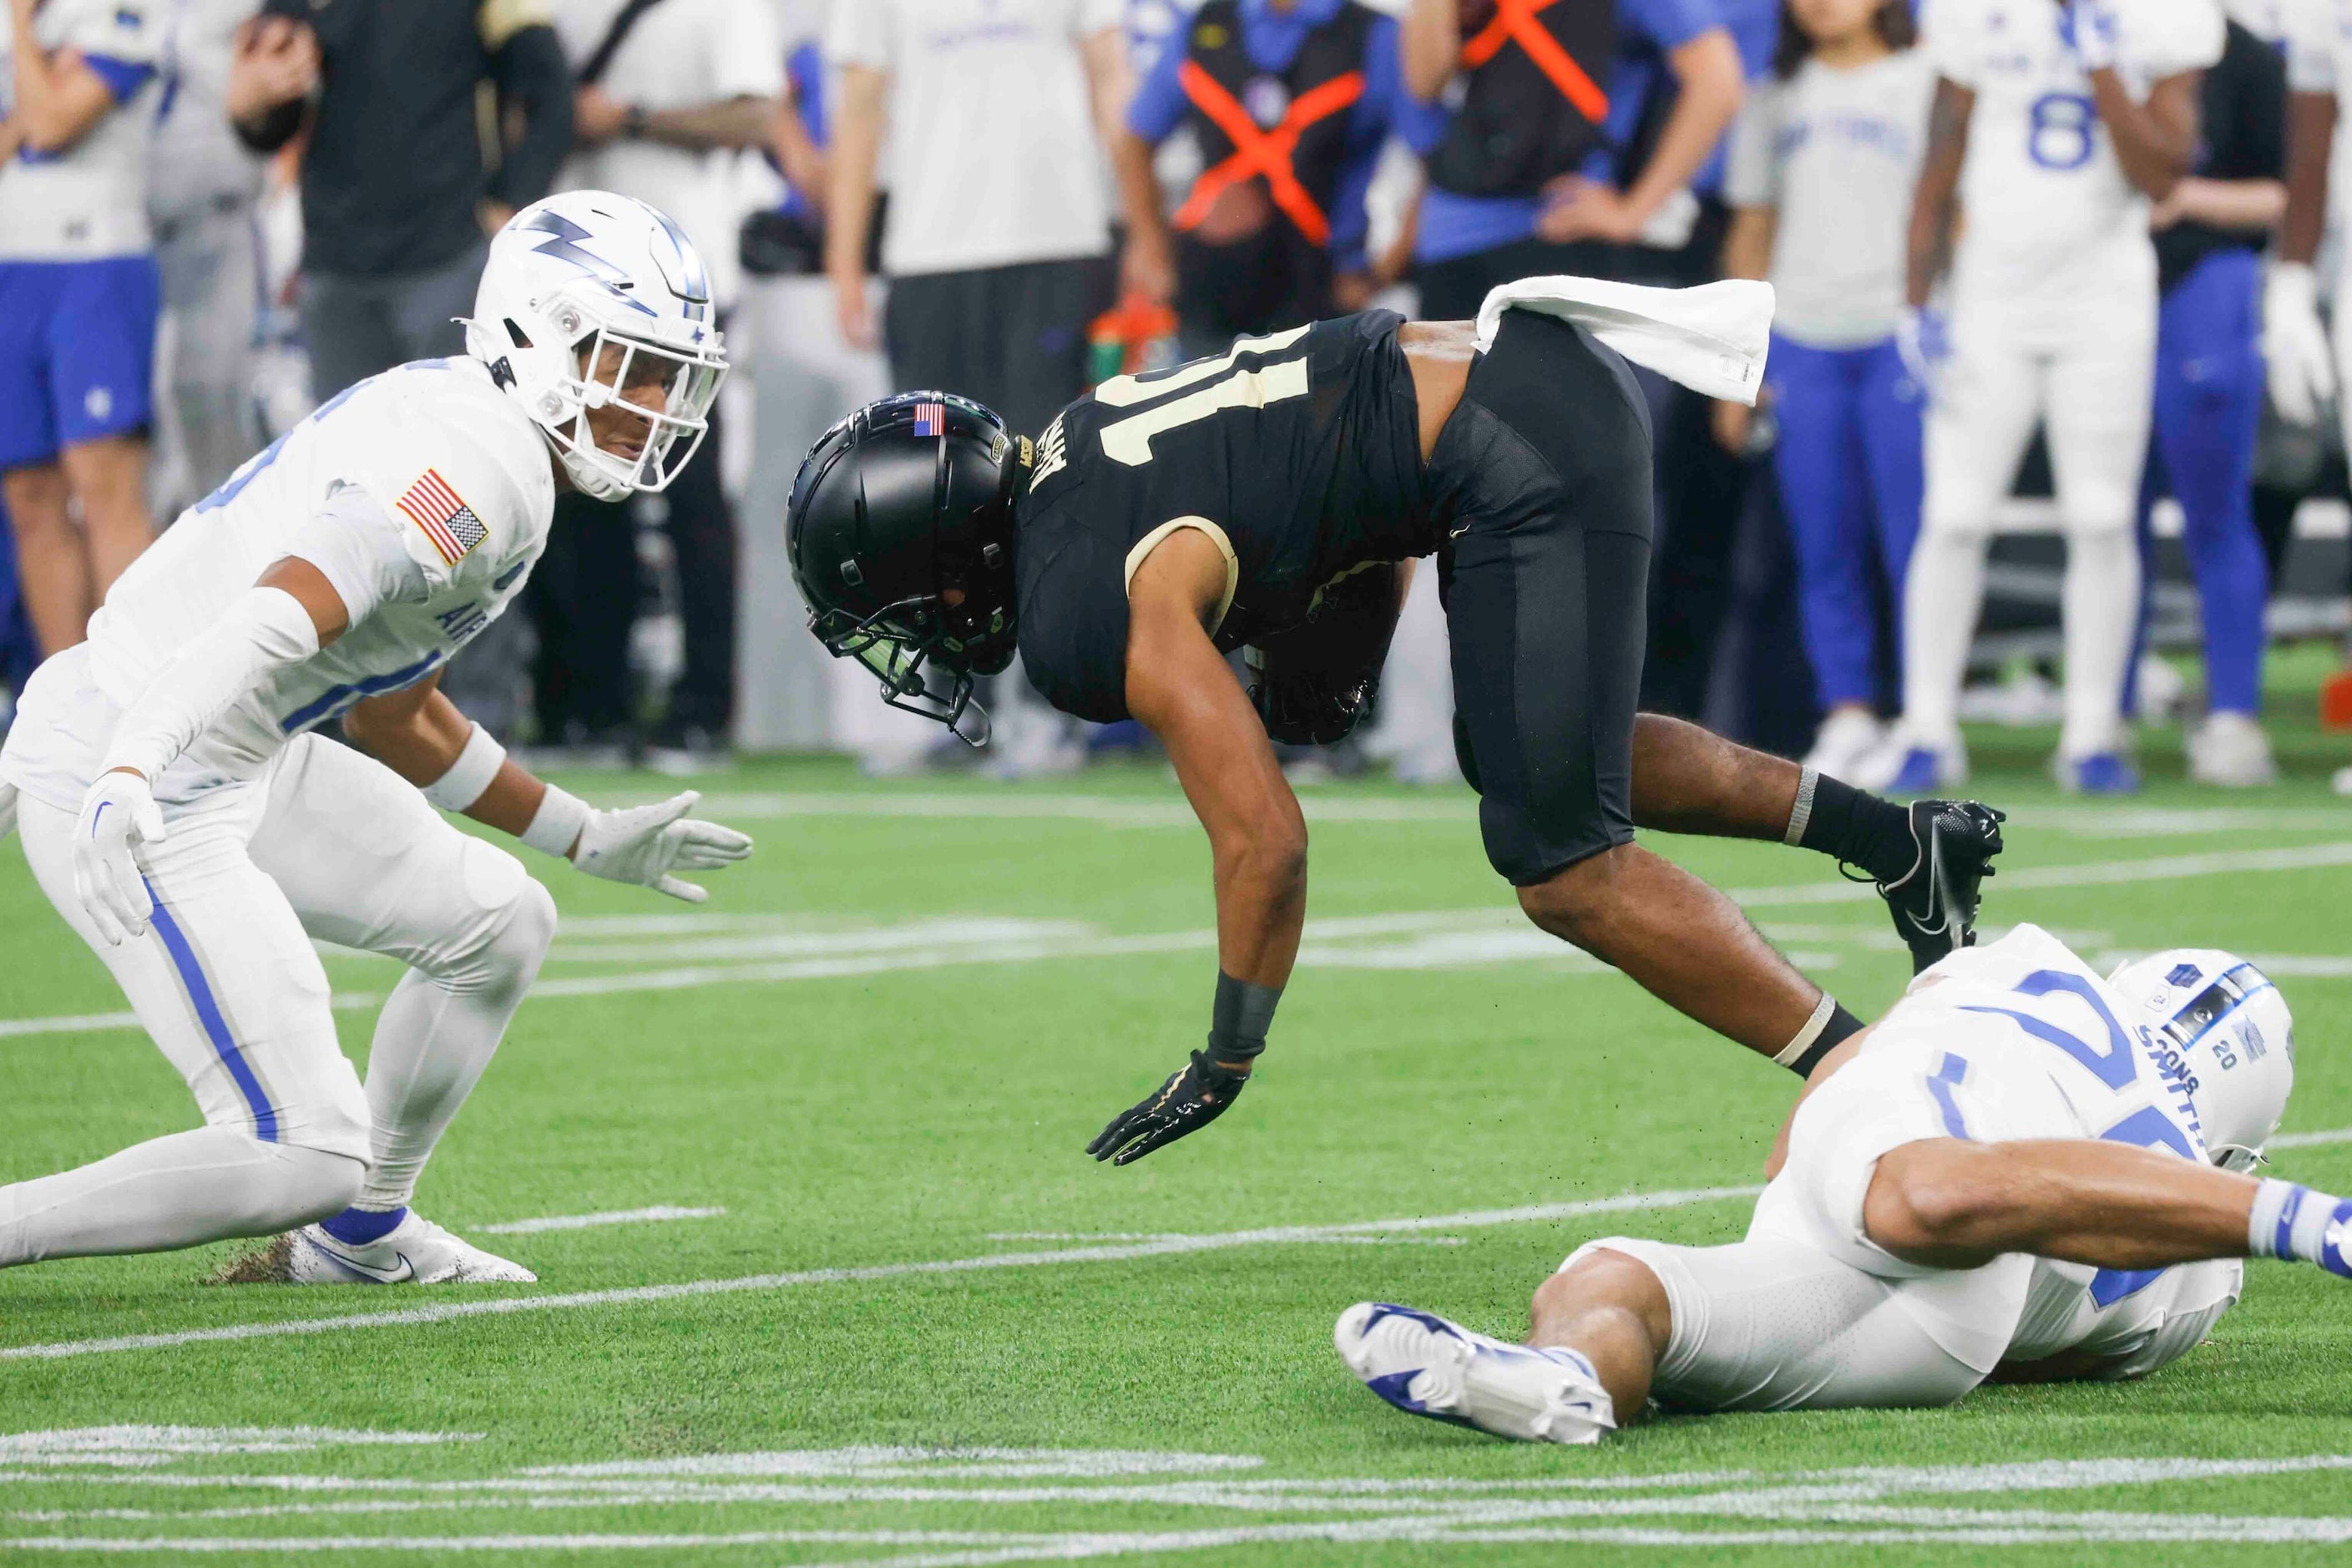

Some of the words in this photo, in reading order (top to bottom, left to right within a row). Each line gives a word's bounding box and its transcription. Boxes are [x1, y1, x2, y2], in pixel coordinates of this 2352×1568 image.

[2030, 94, 2097, 169] 8
[2132, 1024, 2204, 1147] SMITH
[2213, 1039, 2238, 1070] 20
